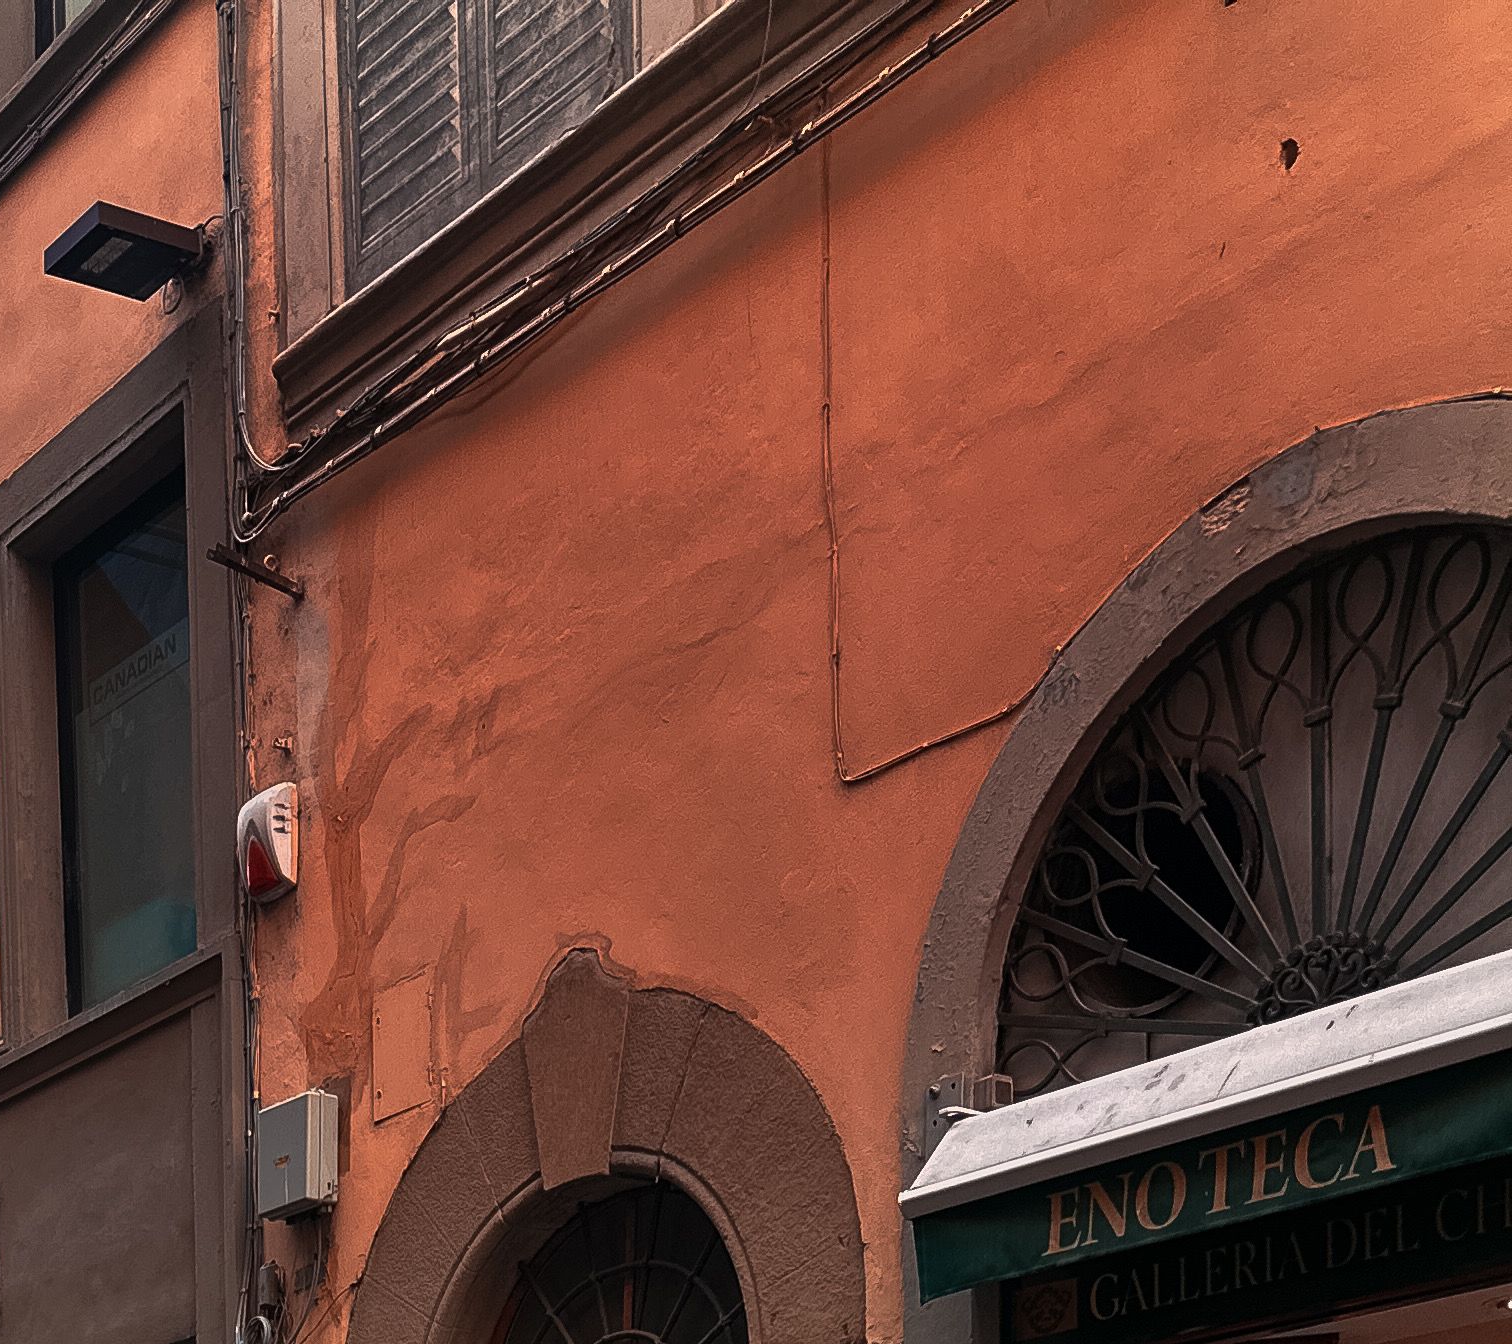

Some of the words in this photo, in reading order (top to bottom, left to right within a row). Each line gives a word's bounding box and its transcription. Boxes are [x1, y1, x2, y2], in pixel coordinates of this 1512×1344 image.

[1042, 1104, 1395, 1257] ENOTECA
[1088, 1231, 1307, 1321] GALLERIA
[1324, 1202, 1421, 1269] DEL
